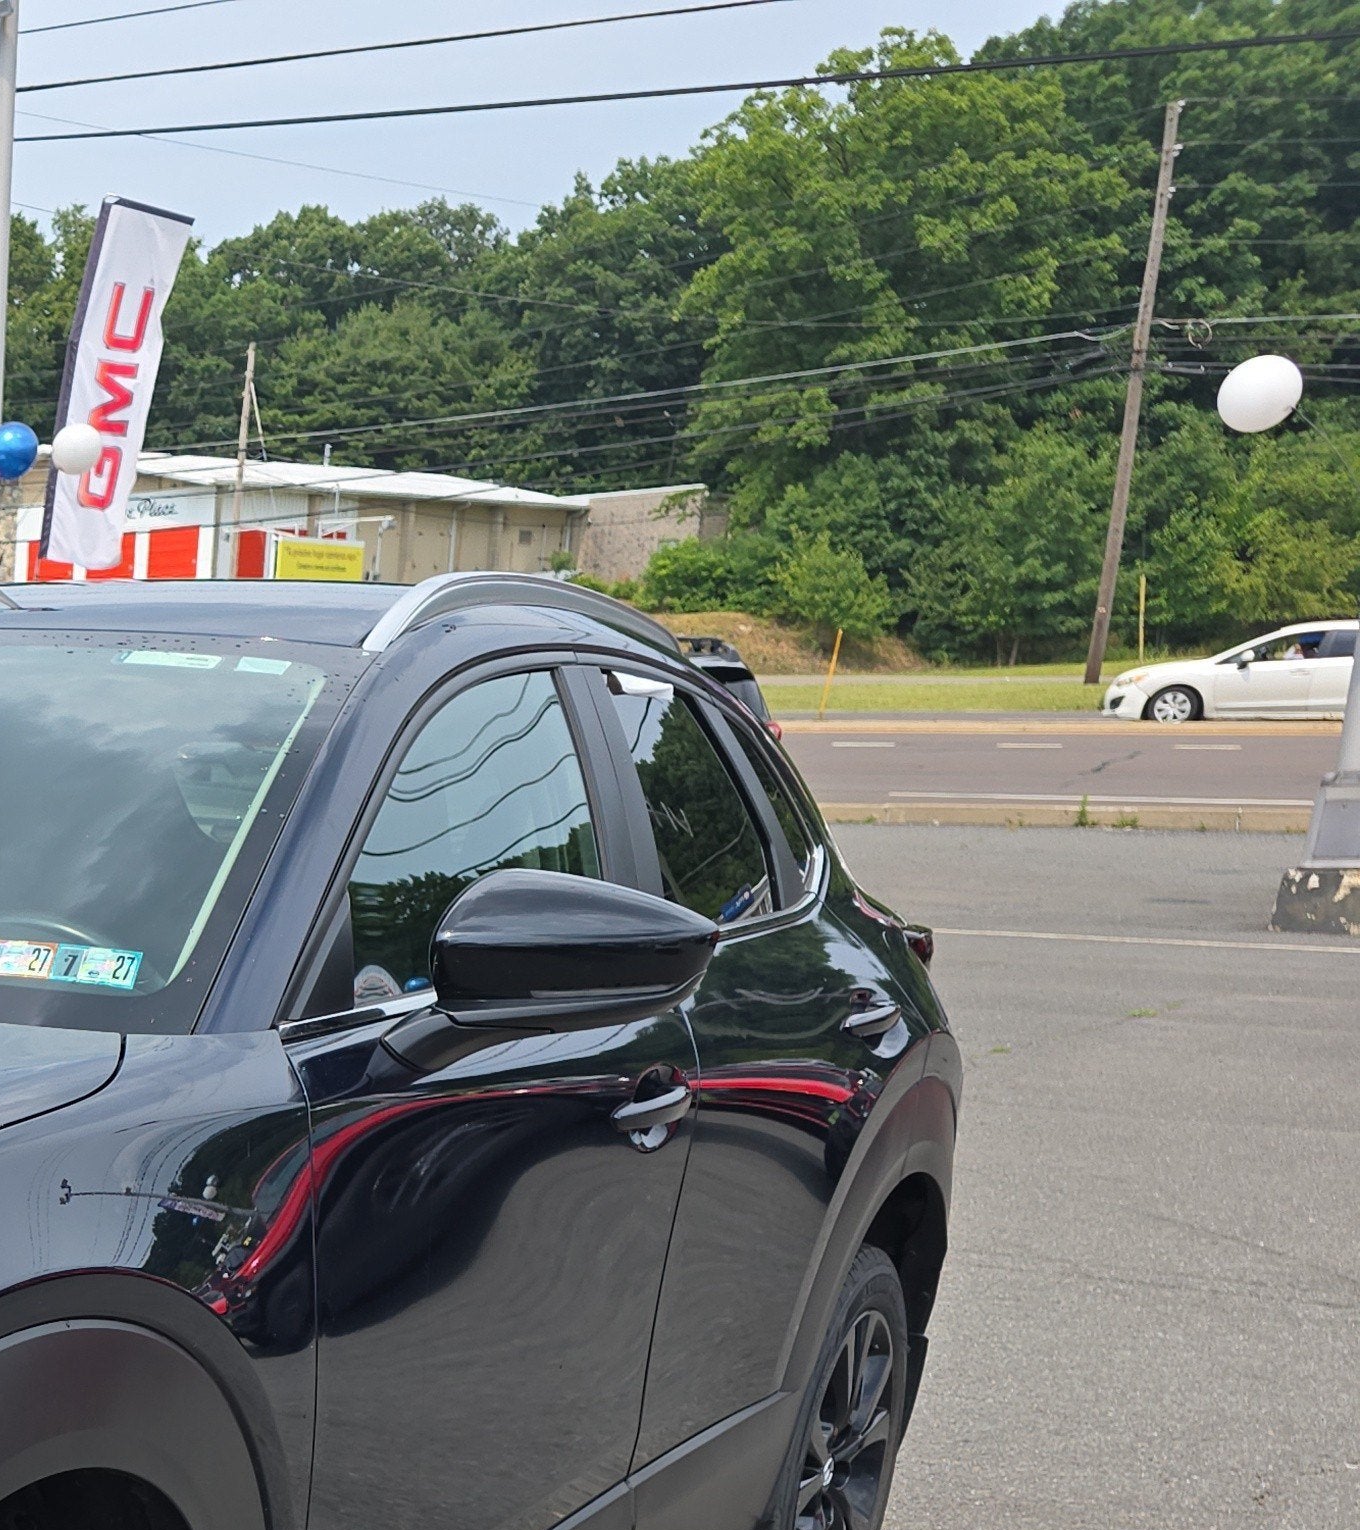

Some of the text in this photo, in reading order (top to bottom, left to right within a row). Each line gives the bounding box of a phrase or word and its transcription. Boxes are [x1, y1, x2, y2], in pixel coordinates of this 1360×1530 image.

[77, 281, 155, 510] GMC
[28, 947, 51, 973] 27
[111, 956, 136, 980] 27
